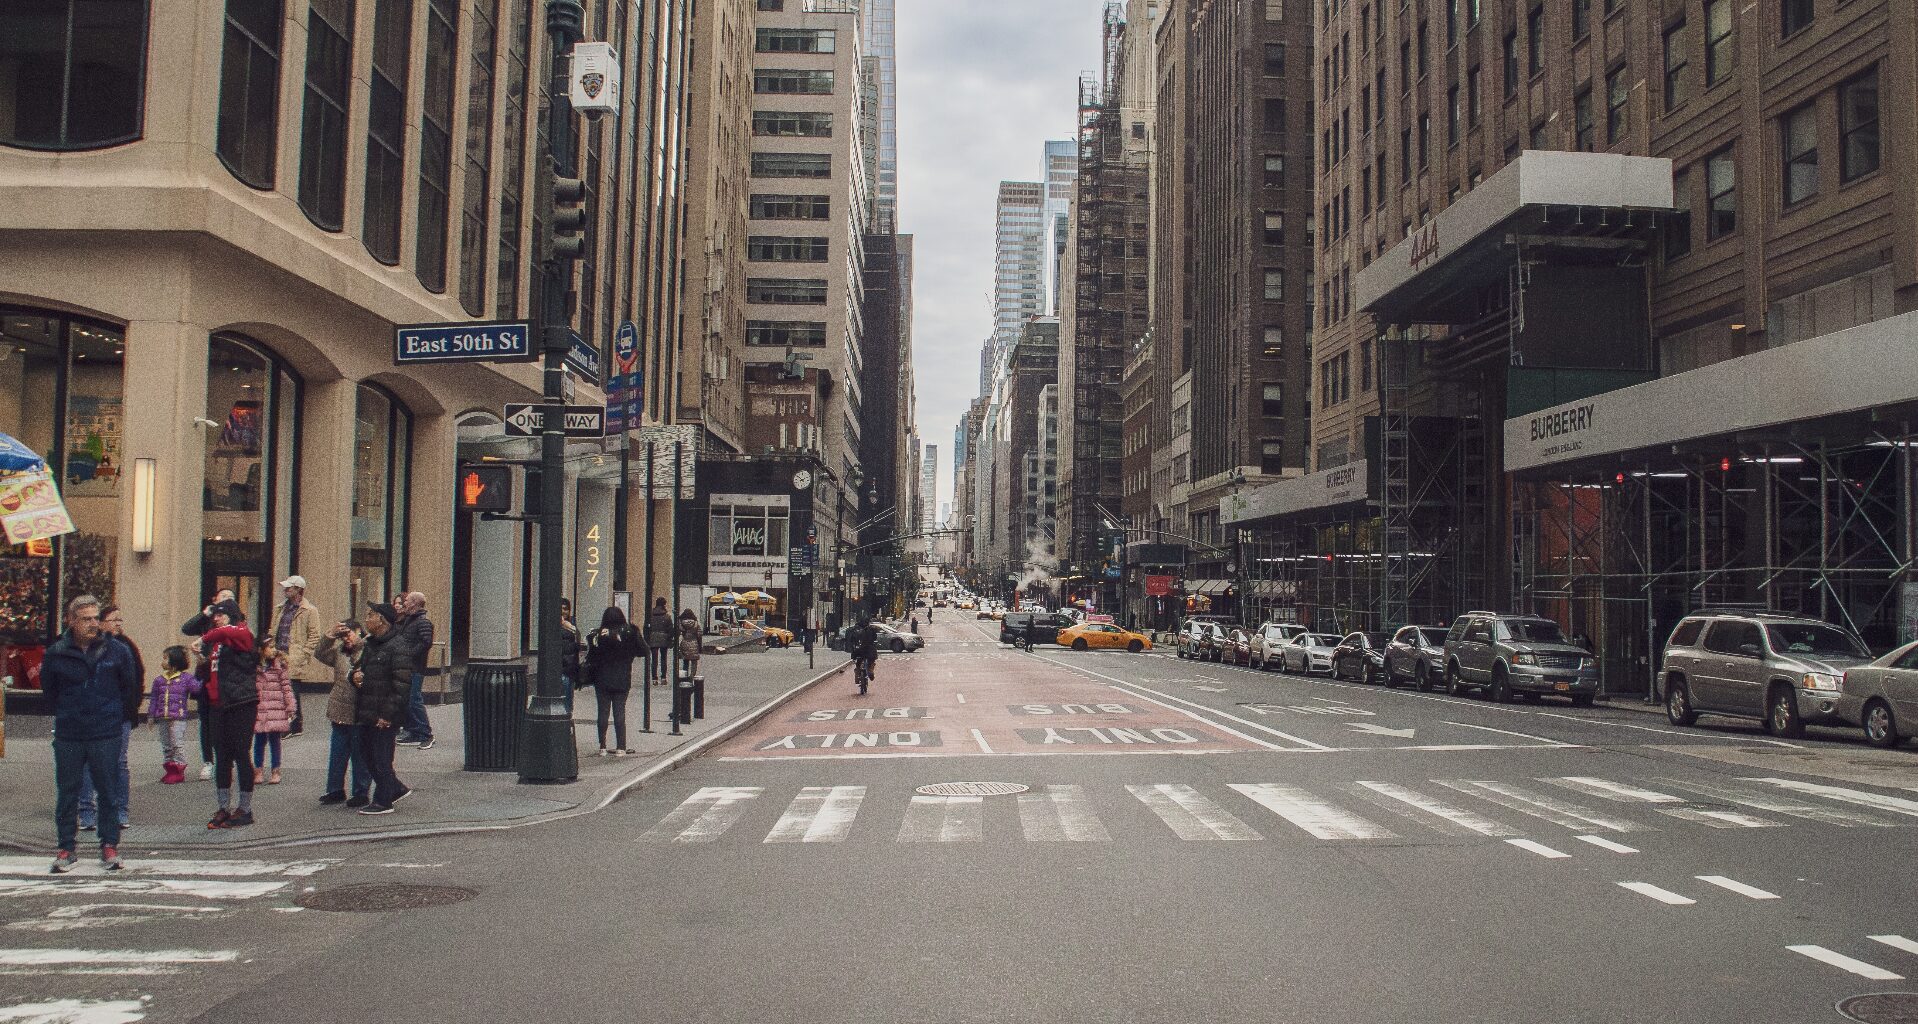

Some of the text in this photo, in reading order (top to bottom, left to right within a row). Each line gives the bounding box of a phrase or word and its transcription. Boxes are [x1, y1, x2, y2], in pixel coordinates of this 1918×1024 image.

[1411, 220, 1439, 271] 444
[406, 332, 519, 353] East 50th St
[565, 415, 595, 427] WAY
[1531, 404, 1594, 441] BURBERRY
[808, 707, 910, 721] BUS
[1022, 704, 1133, 714] BUS
[761, 731, 921, 750] ONLY
[1044, 728, 1199, 744] ONLY
